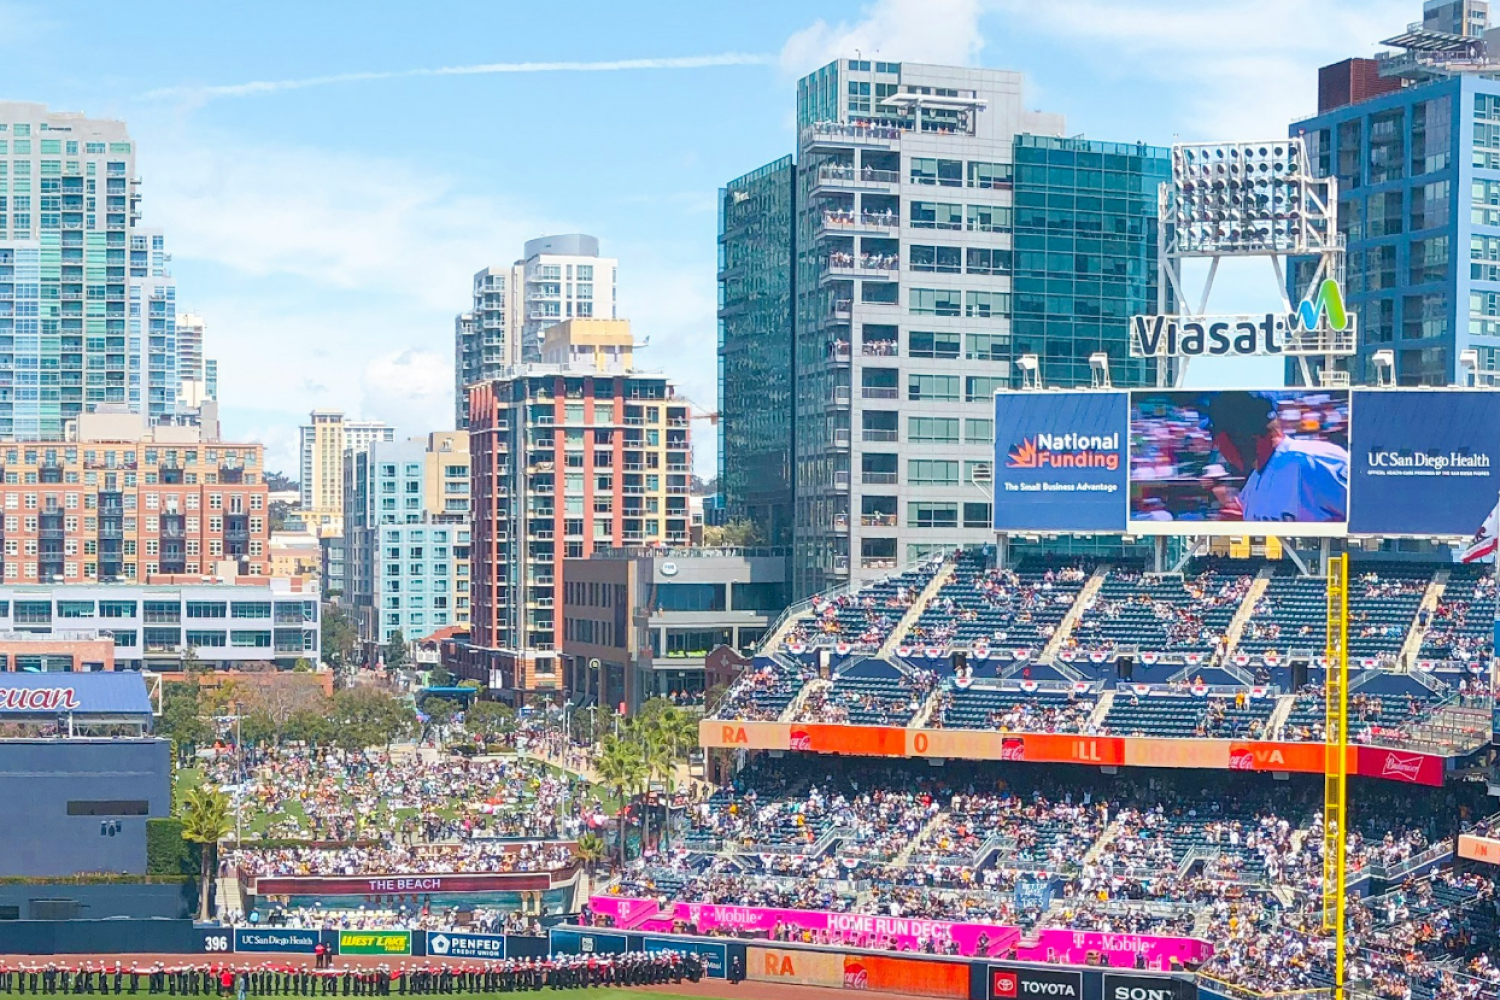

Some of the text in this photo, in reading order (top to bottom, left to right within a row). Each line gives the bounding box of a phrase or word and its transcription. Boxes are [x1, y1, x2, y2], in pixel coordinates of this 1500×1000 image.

[1135, 314, 1280, 356] Viasat
[1038, 433, 1119, 450] National
[1038, 451, 1119, 470] Funding
[1368, 452, 1490, 470] UC San Diego Health
[1004, 482, 1118, 493] The Small Business Advantage
[369, 878, 441, 891] THE BEACH
[827, 914, 952, 940] HOME RUN DECK
[205, 936, 228, 951] 396
[242, 935, 313, 947] UC San Diego Health
[341, 936, 407, 947] WEST LAKE
[452, 939, 500, 950] PENFED
[1102, 936, 1151, 952] Mobile
[1021, 980, 1076, 997] TOYOTA
